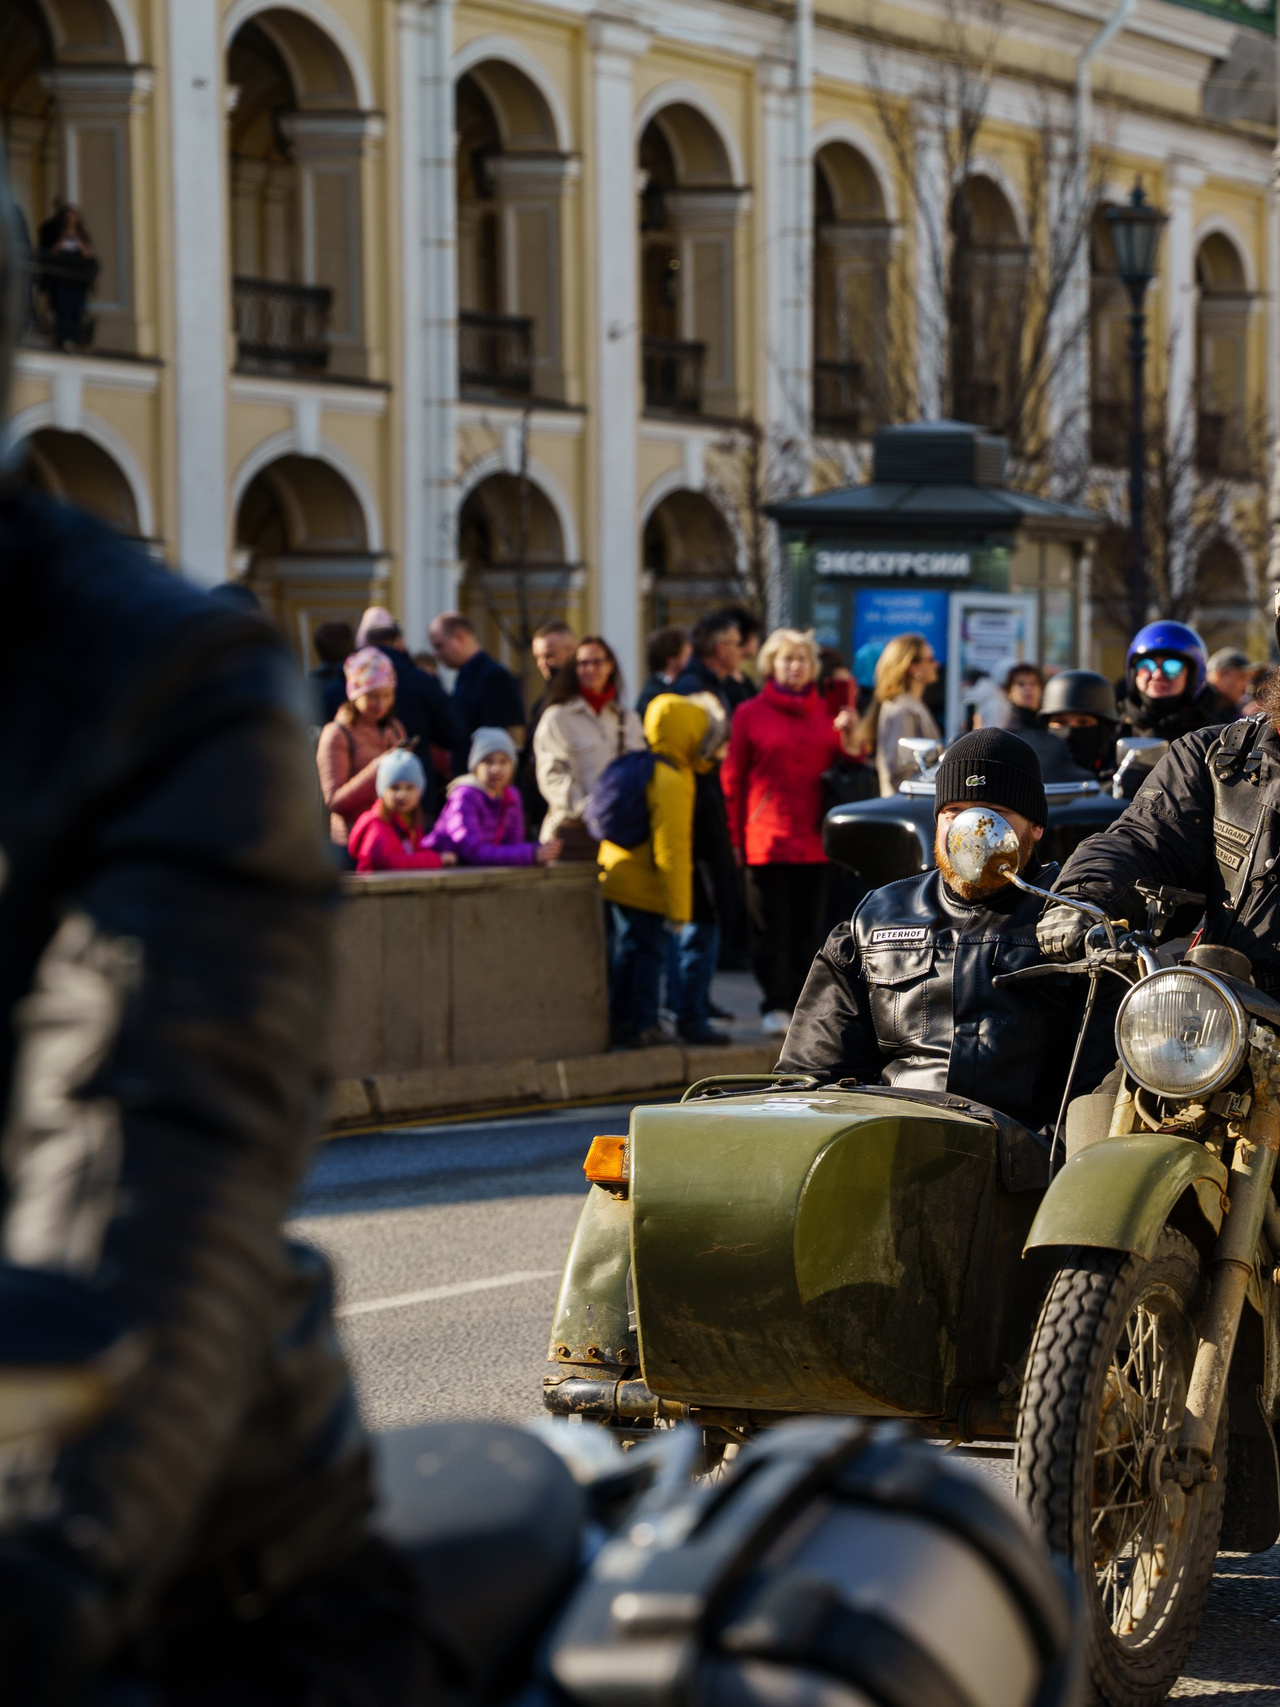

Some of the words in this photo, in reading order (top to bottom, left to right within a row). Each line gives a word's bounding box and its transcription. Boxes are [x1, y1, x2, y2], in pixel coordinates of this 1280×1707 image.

[815, 551, 971, 576] ЭКСКУРСИИ
[1214, 822, 1248, 842] OOLIGANS
[1216, 848, 1237, 866] ERHOF
[875, 930, 922, 940] PETERHOF
